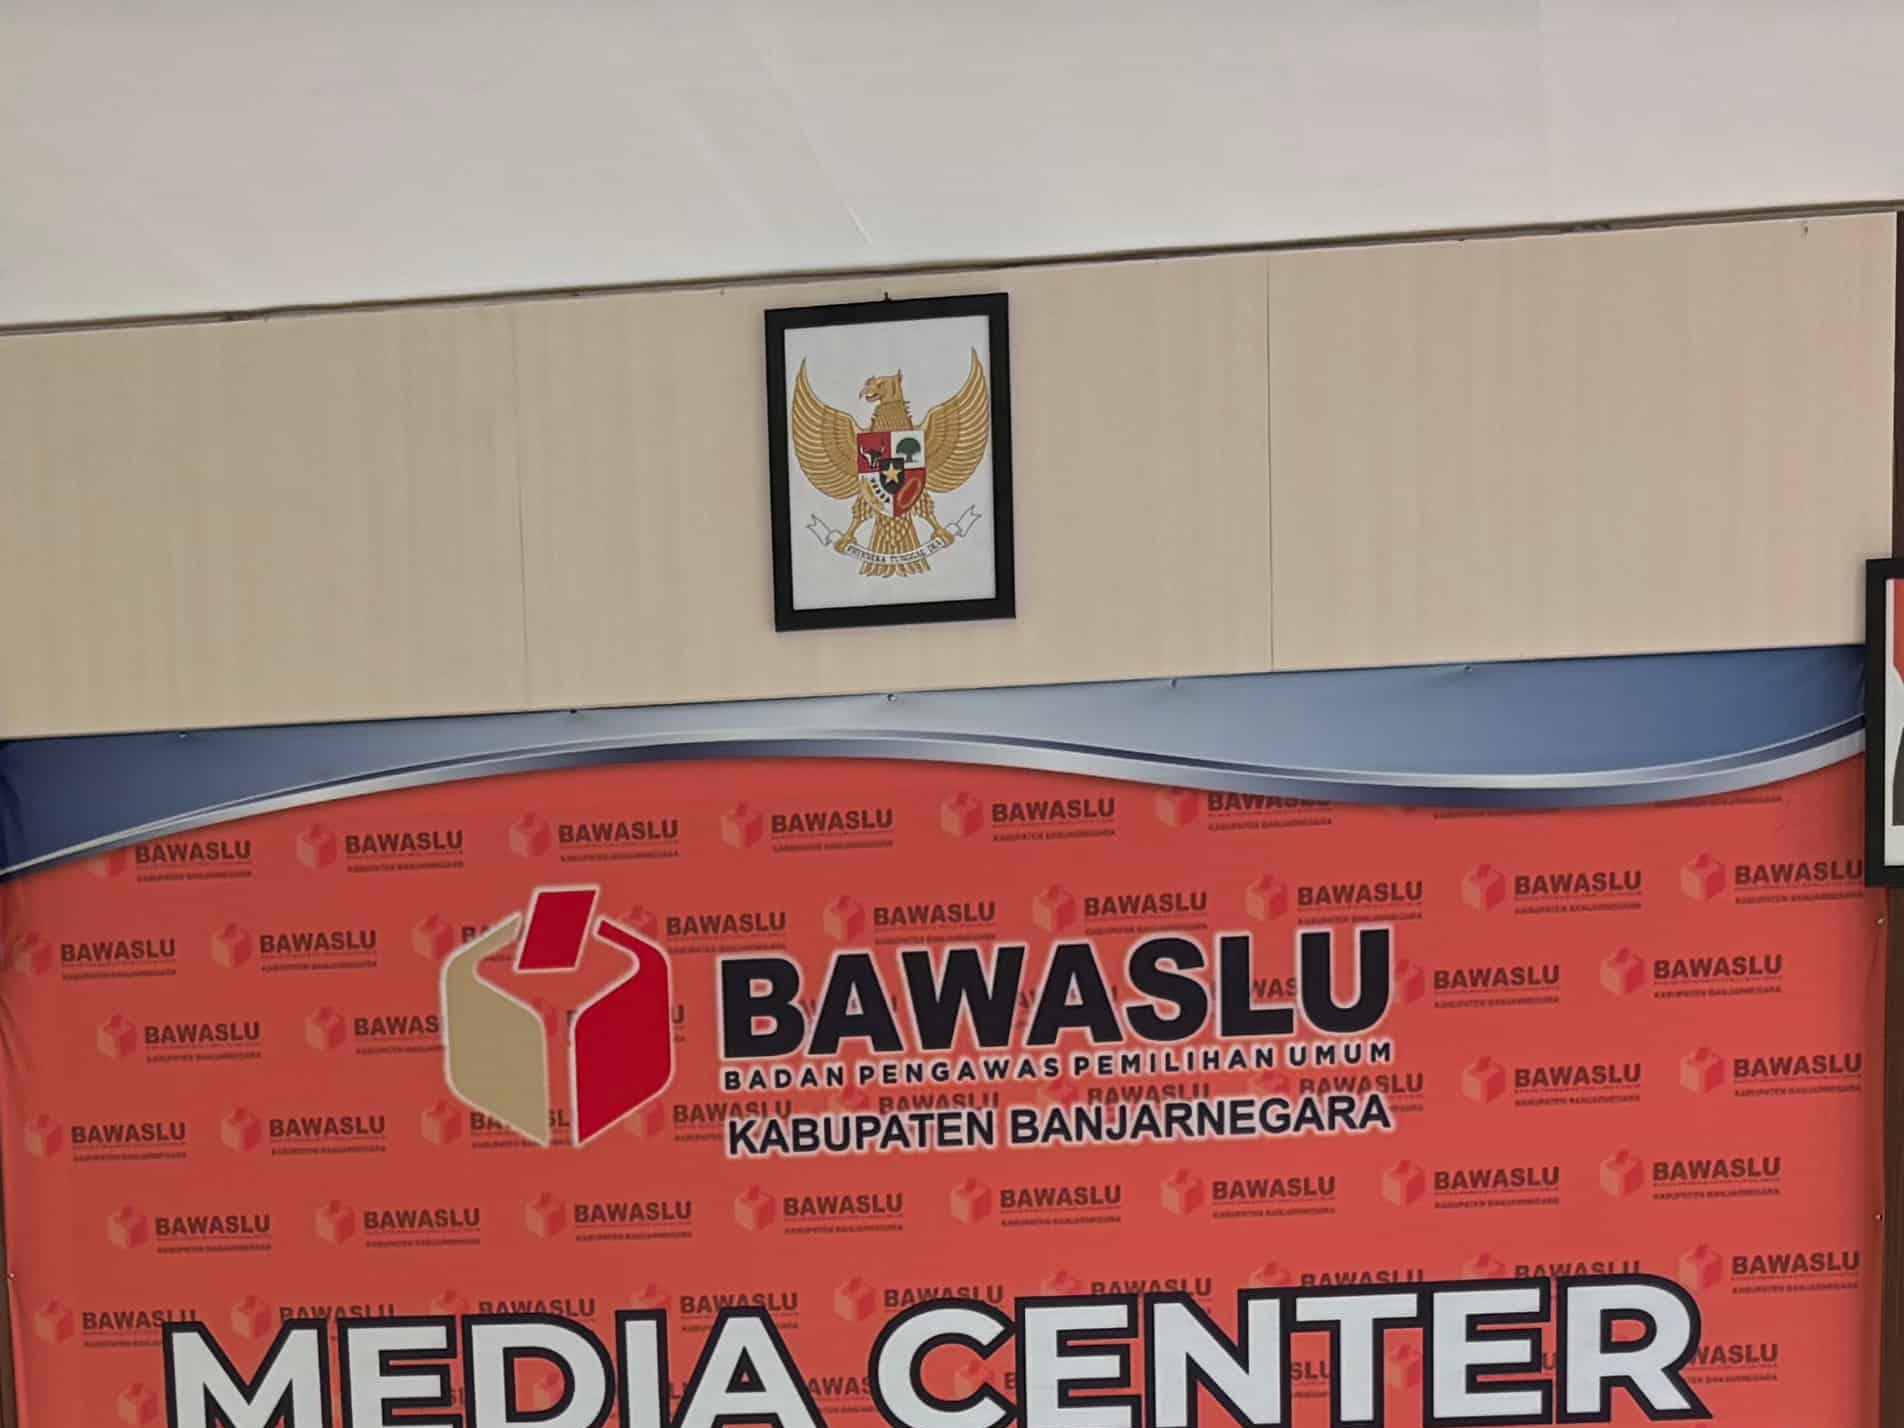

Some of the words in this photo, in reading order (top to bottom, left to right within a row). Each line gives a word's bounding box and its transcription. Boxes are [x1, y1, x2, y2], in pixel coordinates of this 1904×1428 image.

[771, 808, 893, 834] BAWASLU
[992, 798, 1115, 823] BAWASLU
[345, 831, 463, 854] BAWASLU
[558, 819, 679, 844] BAWASLU
[137, 841, 251, 863] BAWASLU
[1514, 870, 1642, 896] BAWASLU
[1734, 861, 1864, 888] BAWASLU
[1084, 892, 1207, 917] BAWASLU
[1297, 880, 1423, 906] BAWASLU
[666, 911, 786, 937] BAWASLU
[873, 901, 996, 926] BAWASLU
[61, 939, 175, 962] BAWASLU
[259, 930, 377, 954] BAWASLU
[1433, 965, 1560, 990] BAWASLU
[1653, 954, 1782, 980] BAWASLU
[720, 929, 1391, 1059] BAWASLU
[145, 1022, 260, 1044] BAWASLU
[354, 1014, 438, 1038] BAWAS
[725, 1066, 844, 1091] BADAN
[859, 1056, 1059, 1085] PENGAWAS
[1074, 1047, 1273, 1076] PEMILIHAN
[1289, 1041, 1392, 1067] UMUM
[1514, 1063, 1641, 1088] BAWASLU
[1733, 1054, 1861, 1078] BAWASLU
[1299, 1073, 1424, 1096] BAWASLU
[71, 1122, 186, 1144] BAWASLU
[269, 1115, 385, 1138] BAWASLU
[727, 1110, 994, 1156] KABUPATEN
[1010, 1093, 1391, 1144] BANJARNEGARA
[1434, 1167, 1560, 1191] BAWASLU
[1652, 1157, 1781, 1181] BAWASLU
[1000, 1185, 1121, 1209] BAWASLU
[1212, 1175, 1336, 1201] BAWASLU
[574, 1200, 692, 1223] BAWASLU
[783, 1193, 903, 1217] BAWASLU
[155, 1214, 271, 1236] BAWASLU
[363, 1208, 480, 1230] BAWASLU
[1732, 1252, 1859, 1275] BAWASLU
